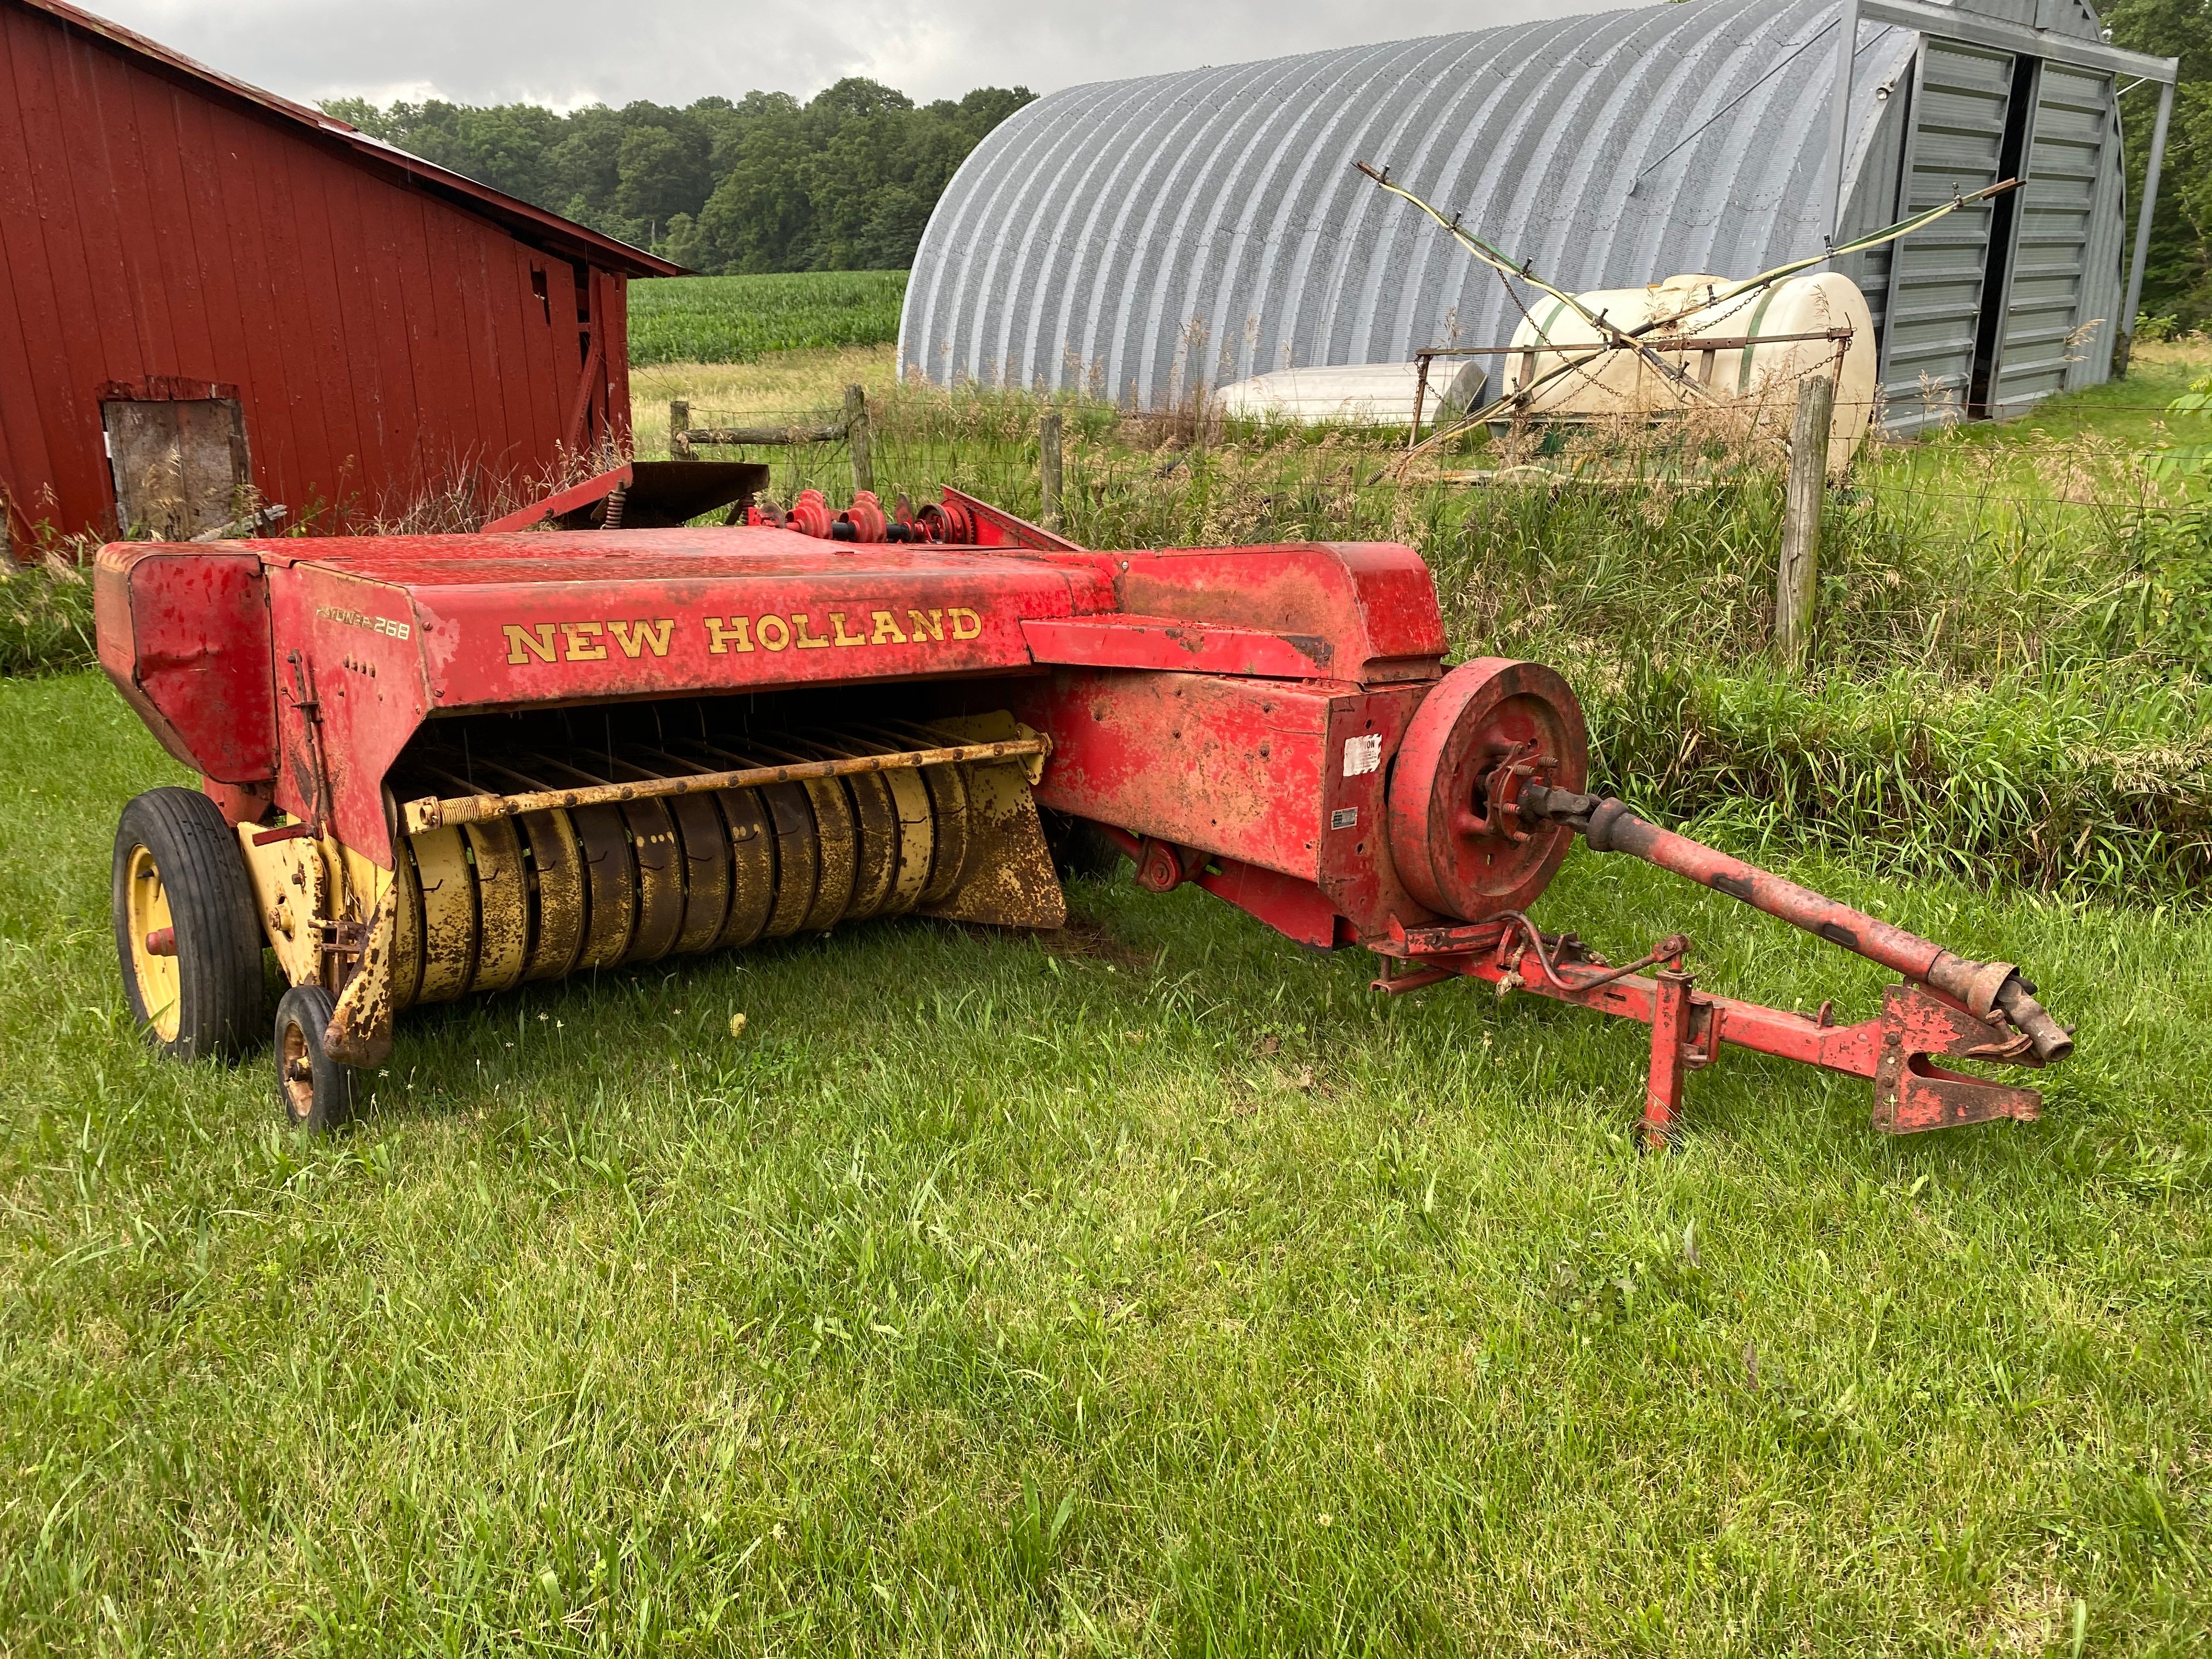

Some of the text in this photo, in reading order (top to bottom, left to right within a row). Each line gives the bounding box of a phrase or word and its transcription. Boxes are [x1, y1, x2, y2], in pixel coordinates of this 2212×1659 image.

[374, 616, 410, 641] 268
[501, 607, 983, 664] NEW HOLLAND
